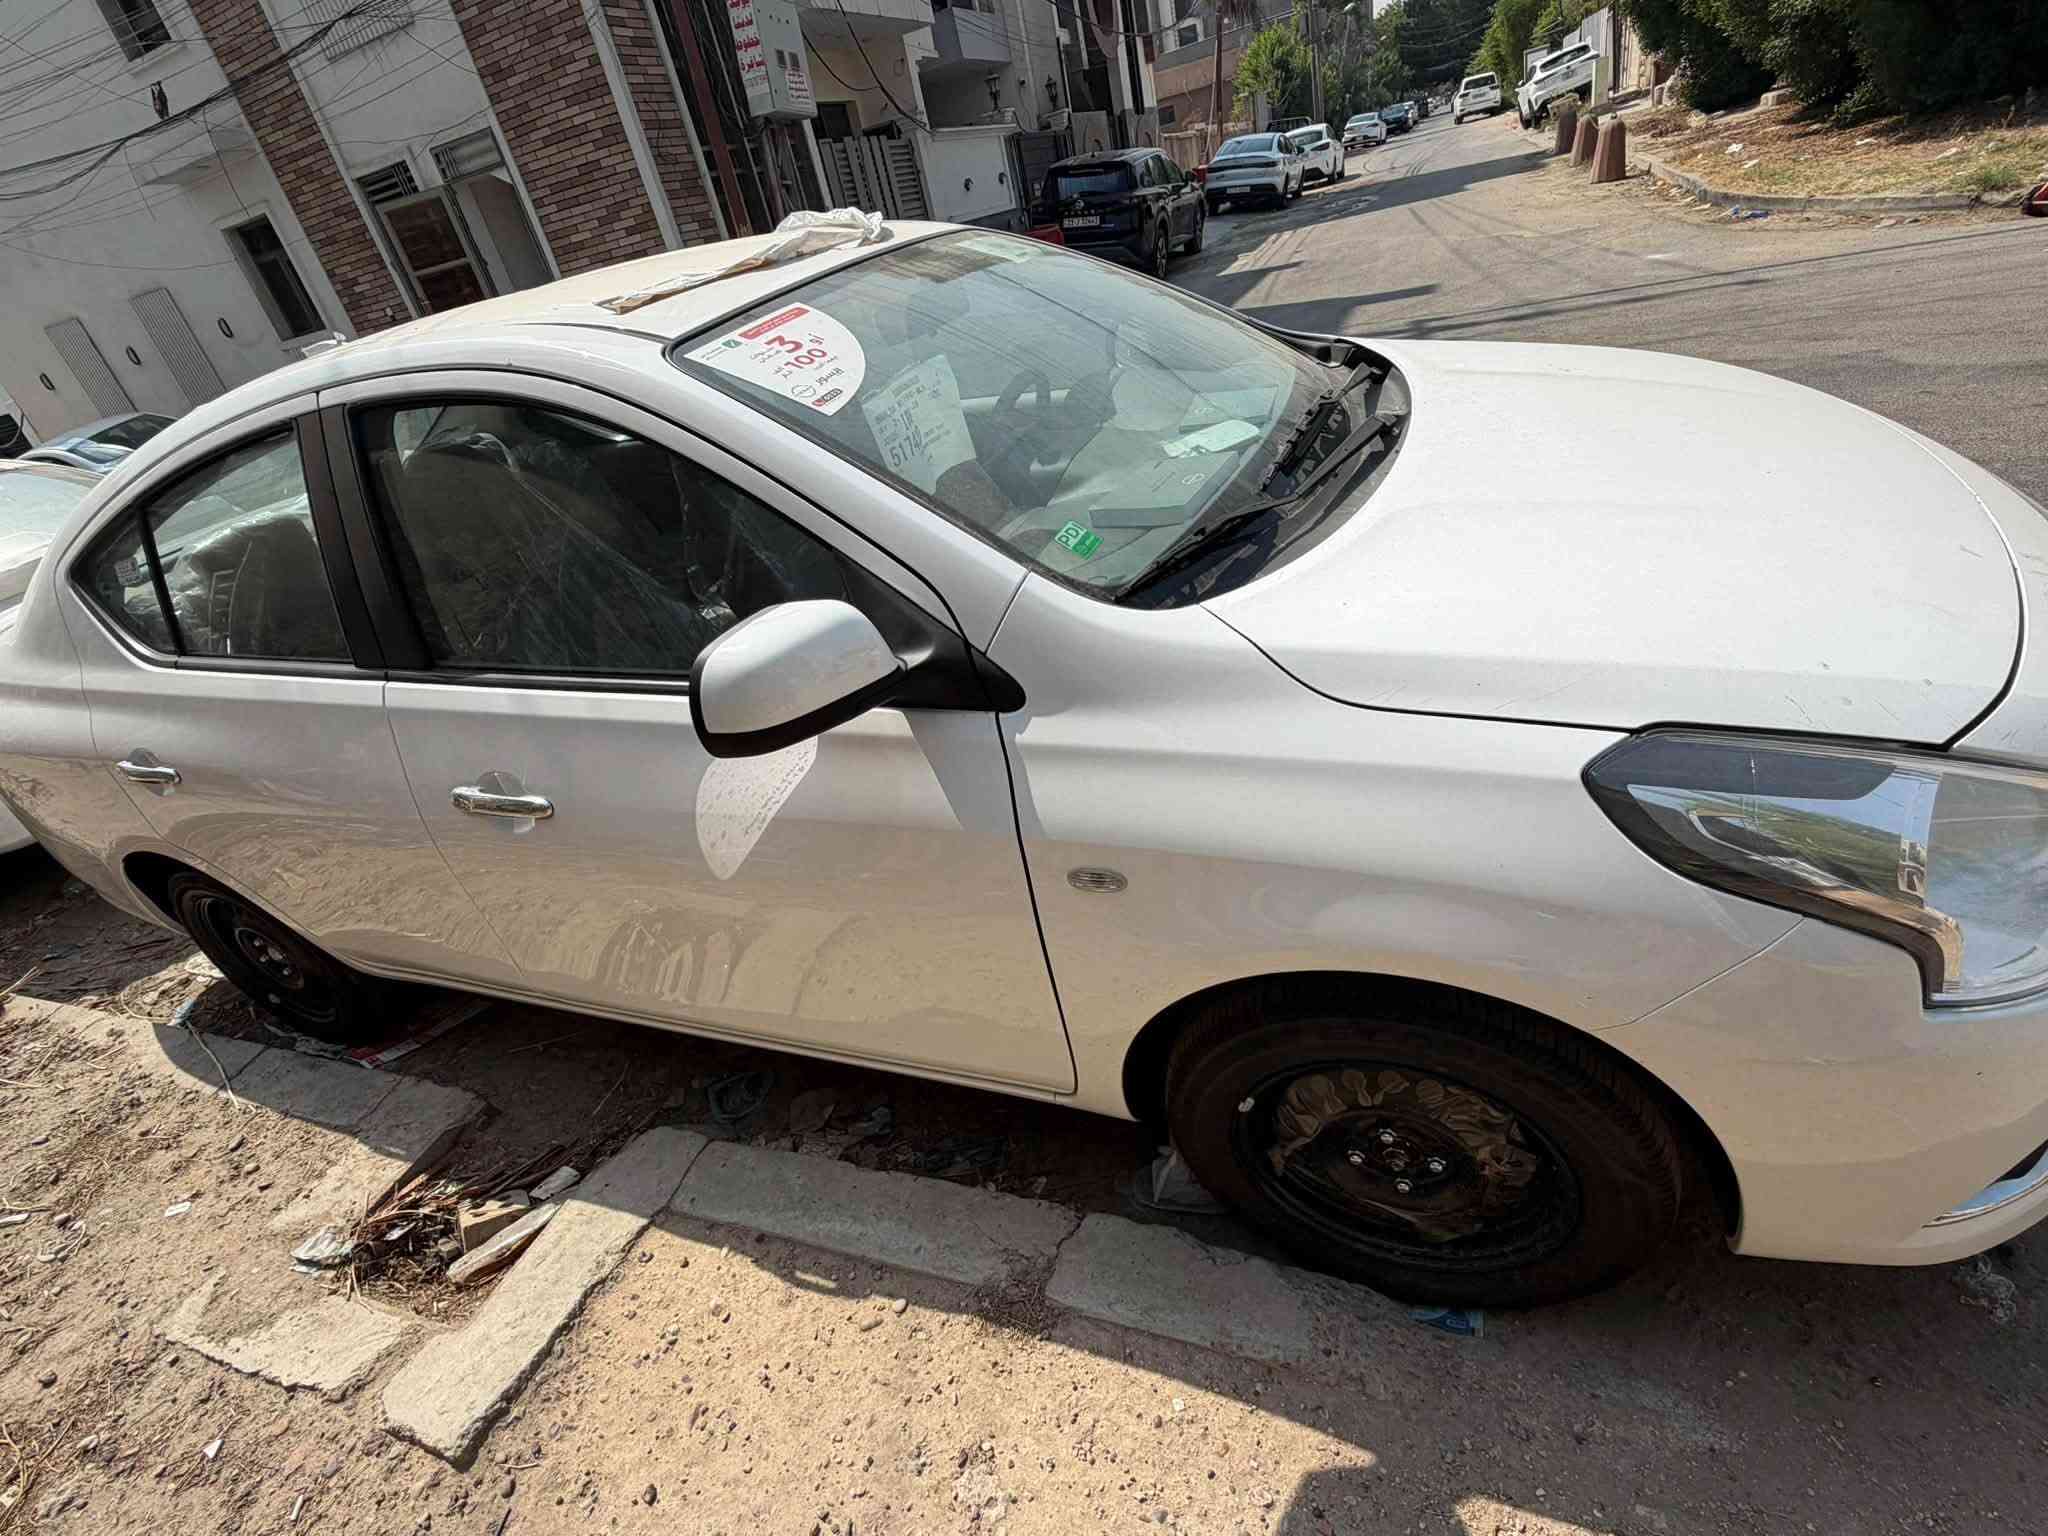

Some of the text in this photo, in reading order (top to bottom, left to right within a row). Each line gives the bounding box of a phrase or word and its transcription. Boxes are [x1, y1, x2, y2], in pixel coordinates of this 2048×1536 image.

[764, 335, 803, 353] 3
[784, 348, 828, 369] 100
[1058, 522, 1085, 547] PDI
